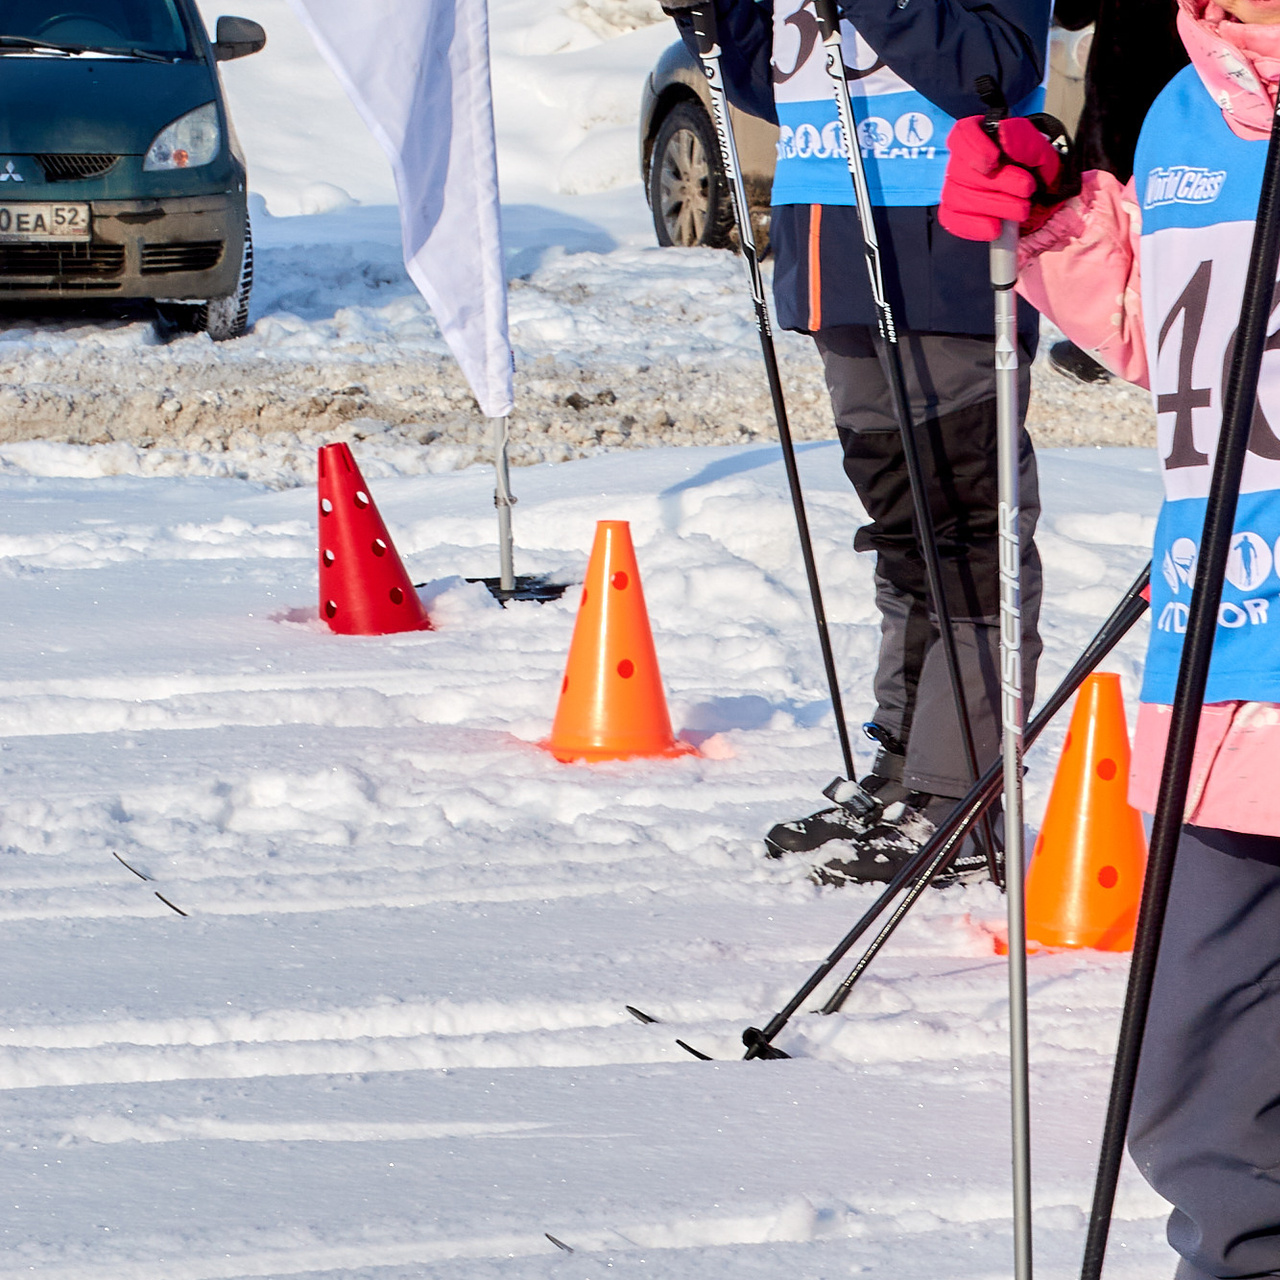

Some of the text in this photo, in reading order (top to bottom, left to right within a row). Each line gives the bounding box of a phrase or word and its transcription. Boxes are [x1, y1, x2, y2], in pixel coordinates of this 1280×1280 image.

[1146, 171, 1221, 204] World Class
[55, 207, 79, 225] 52
[883, 302, 898, 343] NORDWAY
[999, 502, 1022, 735] FISCHER
